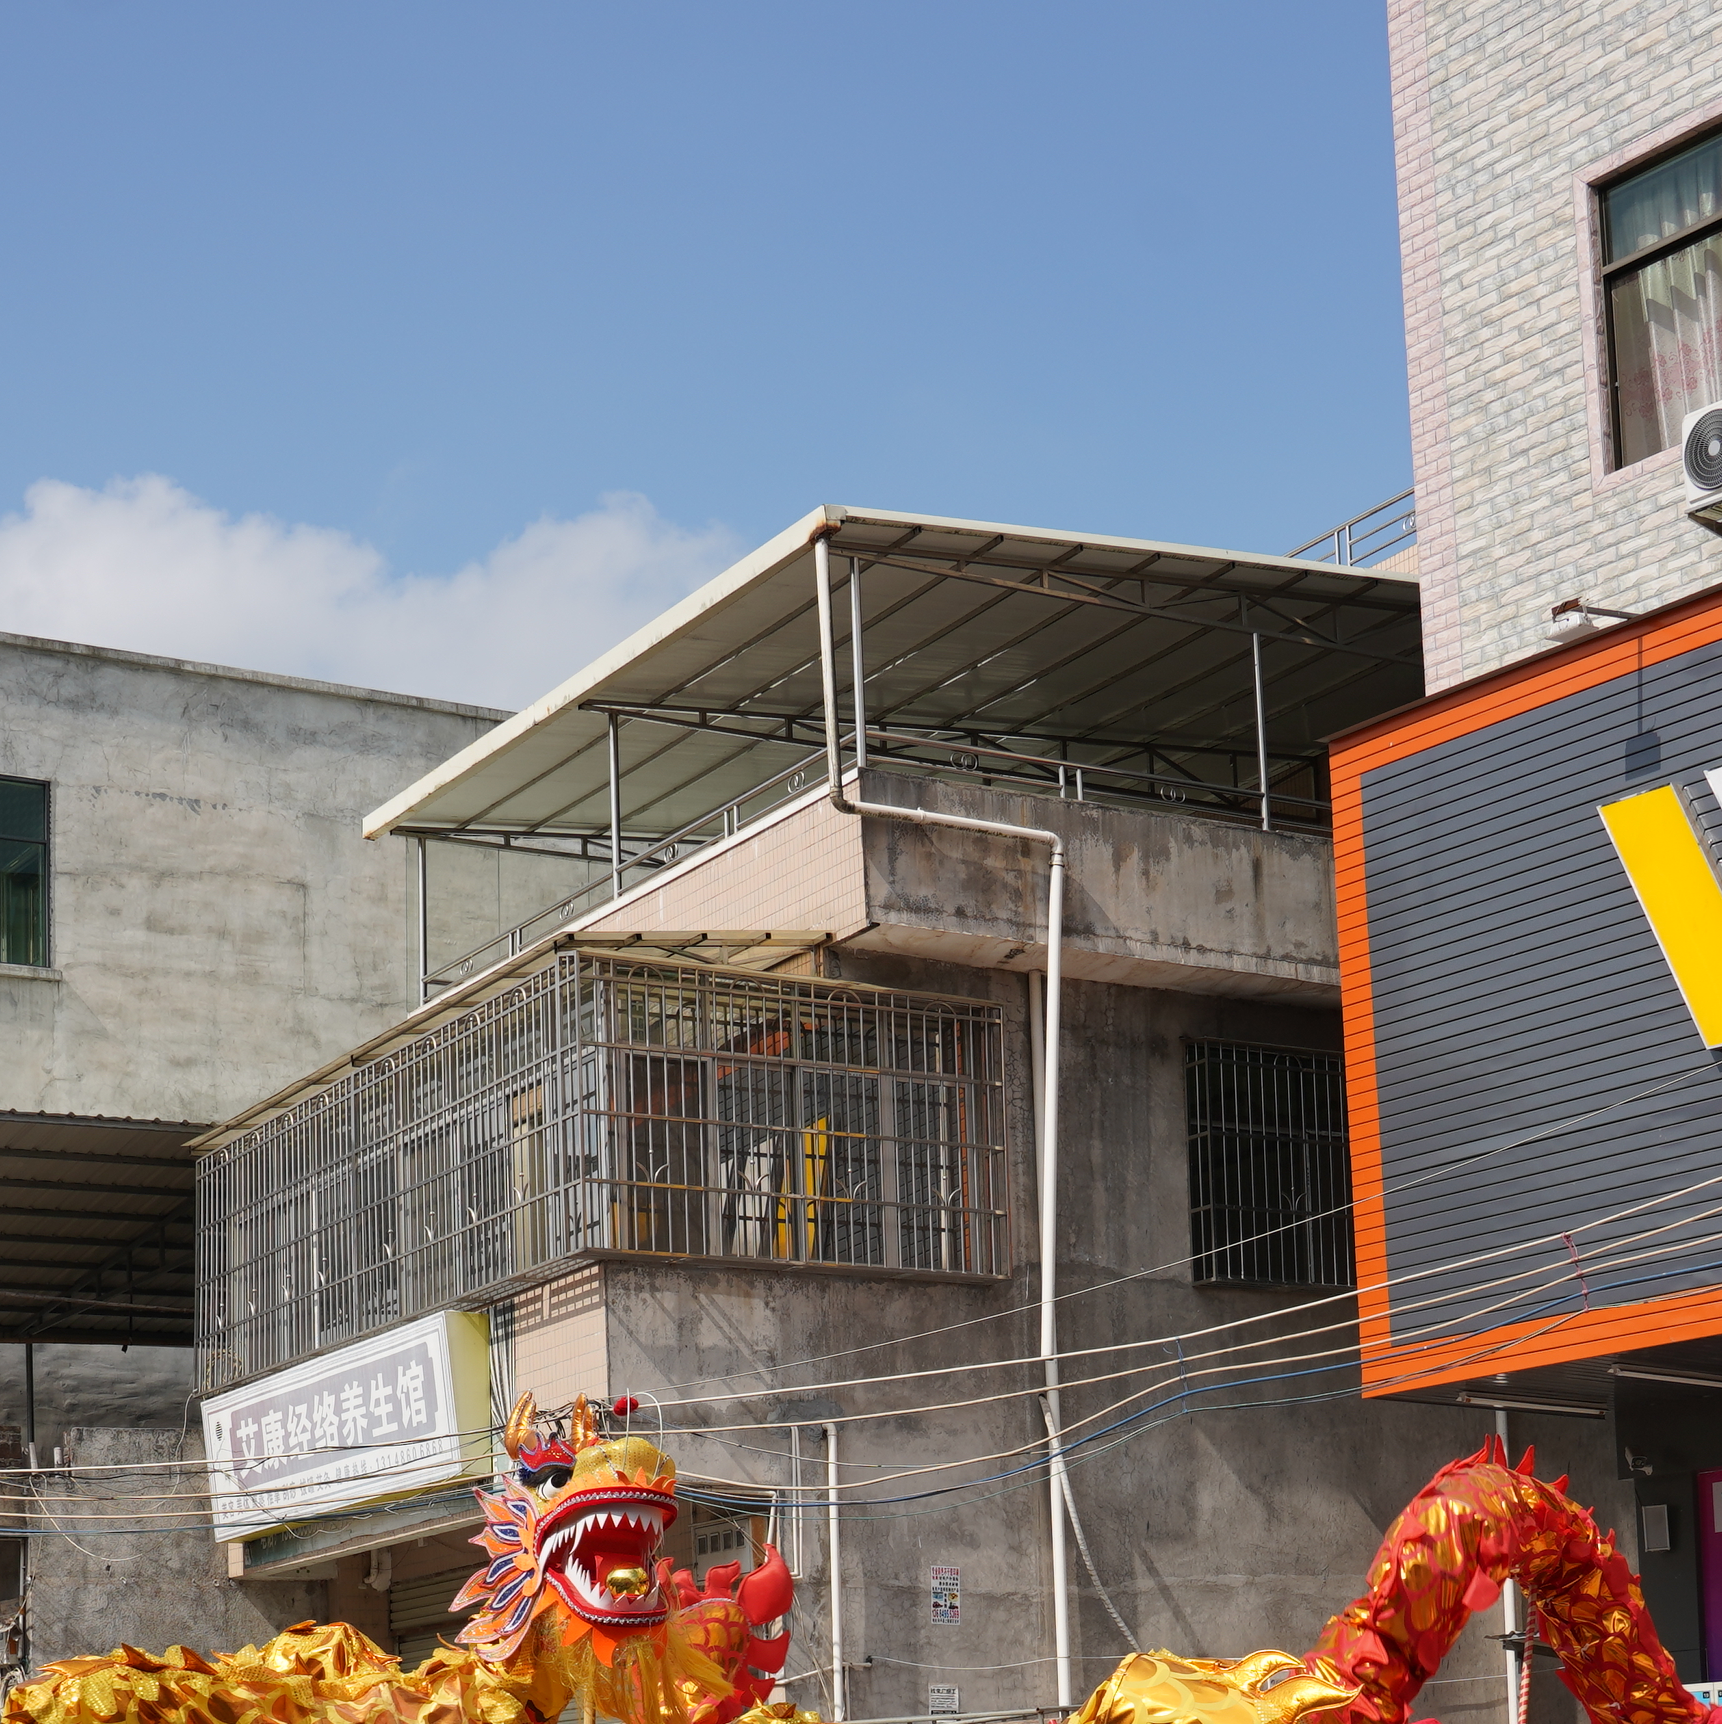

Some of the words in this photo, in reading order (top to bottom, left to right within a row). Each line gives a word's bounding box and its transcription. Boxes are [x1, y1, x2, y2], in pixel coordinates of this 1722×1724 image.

[235, 1358, 428, 1480] 艾康经络养生馆
